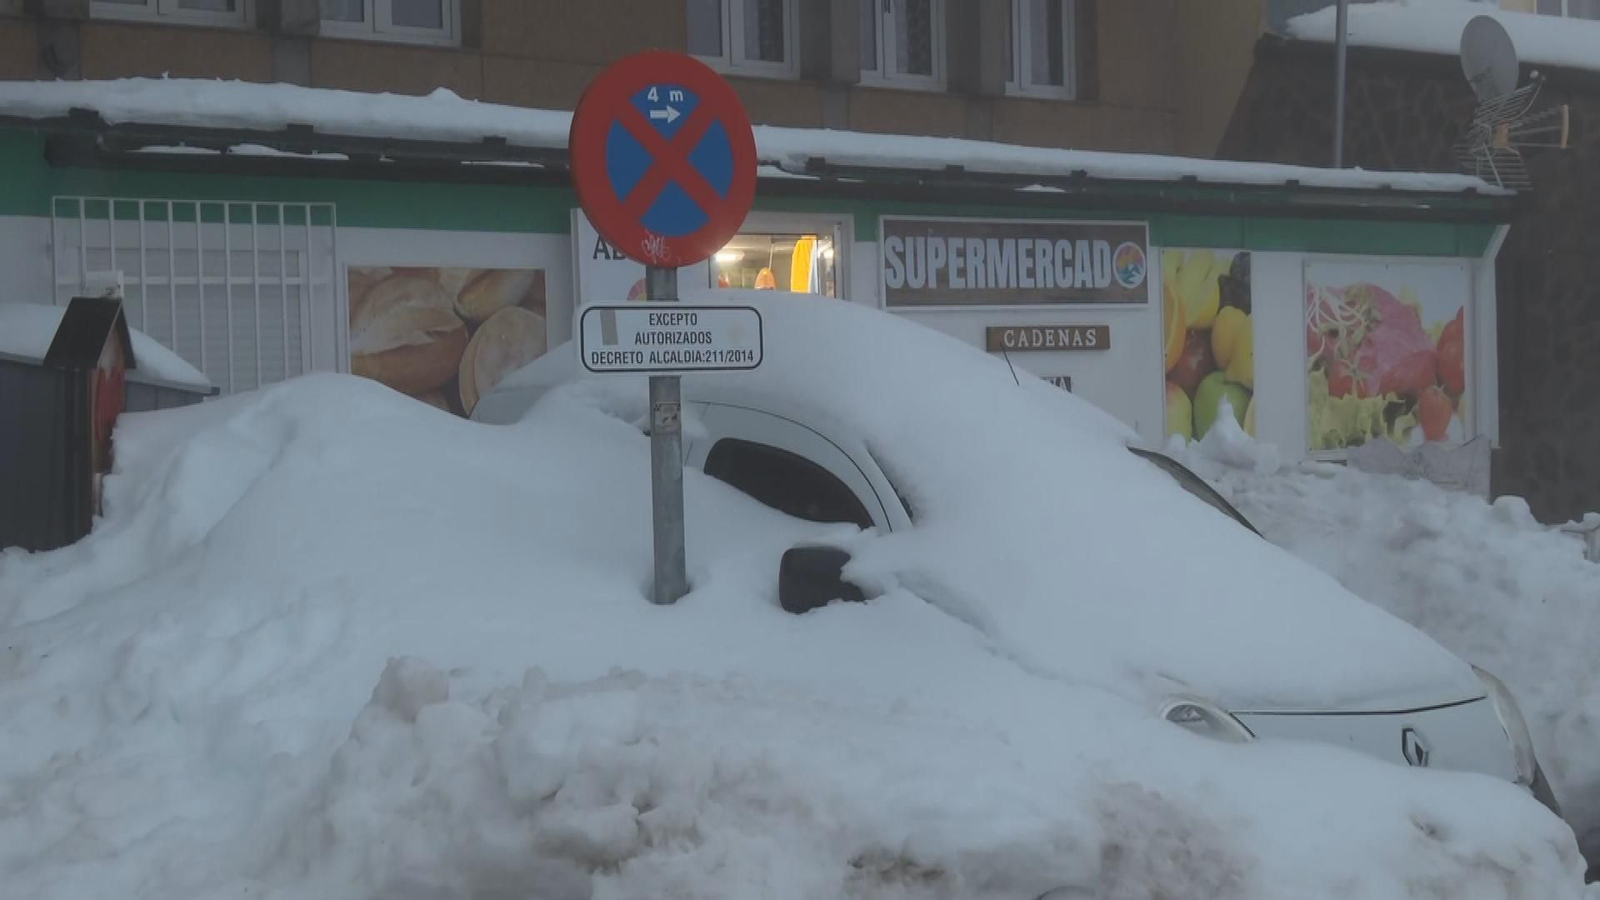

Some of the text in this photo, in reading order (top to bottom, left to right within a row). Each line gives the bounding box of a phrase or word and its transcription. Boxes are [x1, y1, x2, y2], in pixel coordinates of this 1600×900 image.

[647, 86, 684, 103] 4 m
[649, 313, 698, 326] EXCEPTO
[634, 331, 712, 345] AUTORIZADOS
[1003, 329, 1097, 348] CADENAS
[591, 351, 643, 364] DECRETO
